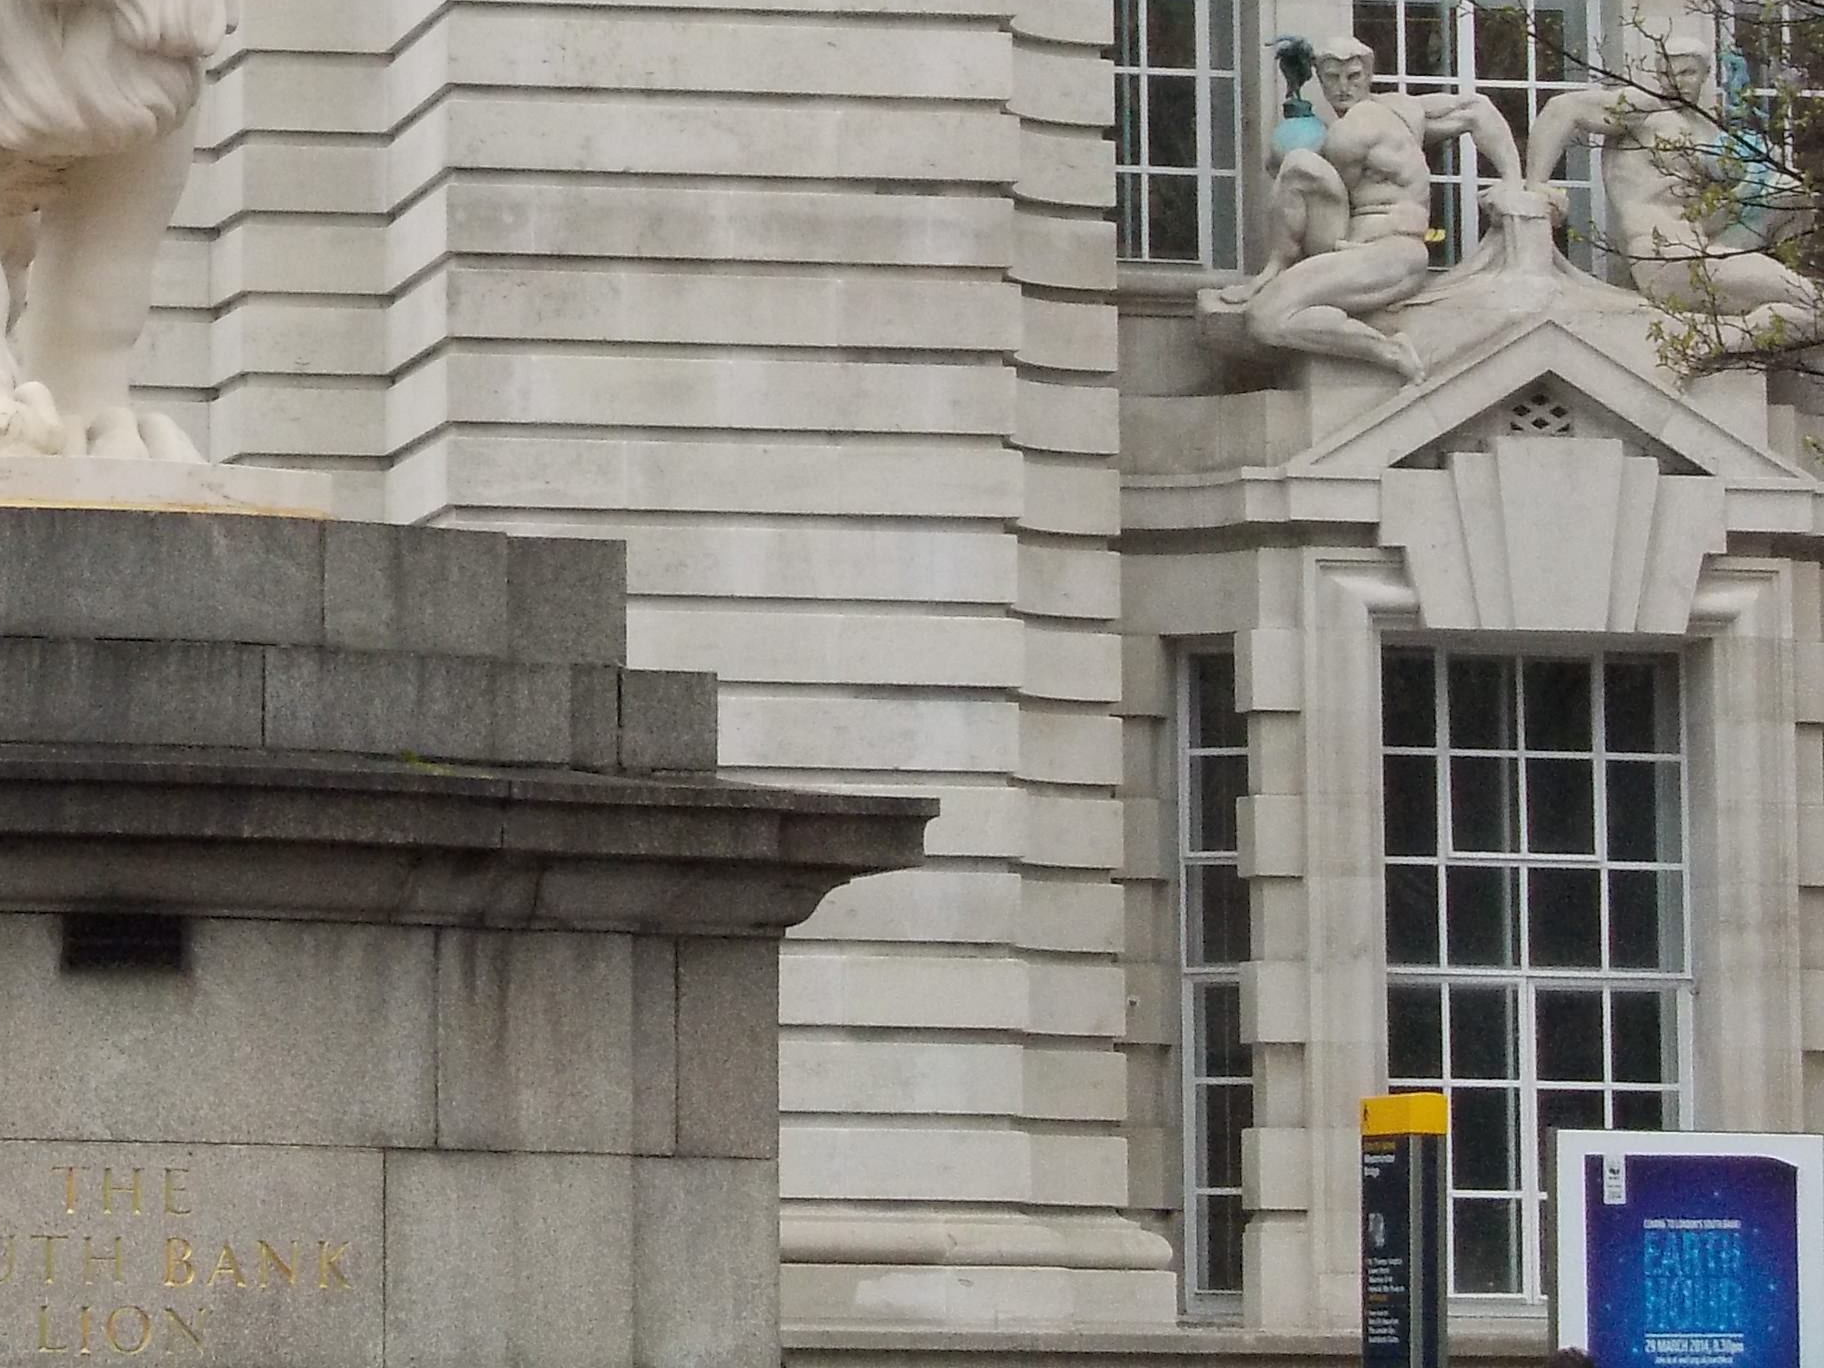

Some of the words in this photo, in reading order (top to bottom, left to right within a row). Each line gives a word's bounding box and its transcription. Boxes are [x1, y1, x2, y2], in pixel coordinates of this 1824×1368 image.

[51, 1166, 193, 1216] THE
[163, 1236, 353, 1289] BANK
[1643, 1231, 1743, 1277] EARTH
[36, 1303, 212, 1356] LION
[1657, 1338, 1688, 1352] MARCH
